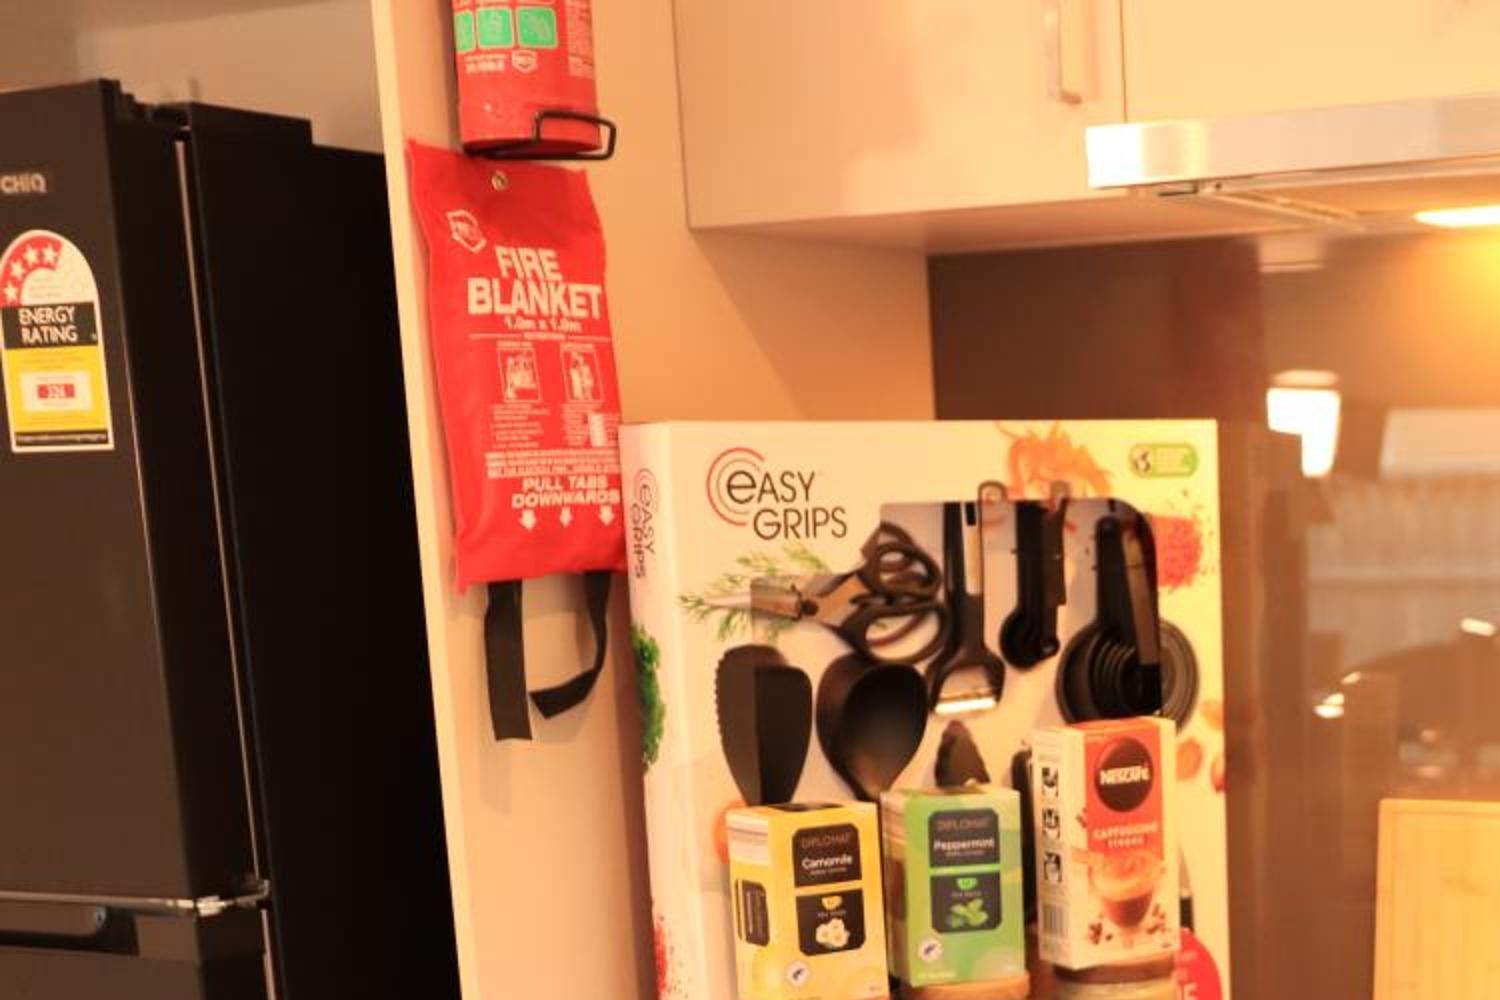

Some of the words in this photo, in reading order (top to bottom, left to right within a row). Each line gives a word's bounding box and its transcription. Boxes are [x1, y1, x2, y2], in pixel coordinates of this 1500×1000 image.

[495, 245, 563, 281] FIRE
[467, 278, 602, 319] BLANKET
[18, 306, 75, 325] ENERGY
[21, 325, 78, 344] RATING
[522, 476, 563, 491] PULL
[568, 475, 608, 489] TABS
[511, 488, 620, 509] DOWNWARDS
[752, 506, 848, 540] GRIPS
[934, 837, 995, 852] Peppermint
[801, 853, 853, 869] Camomile
